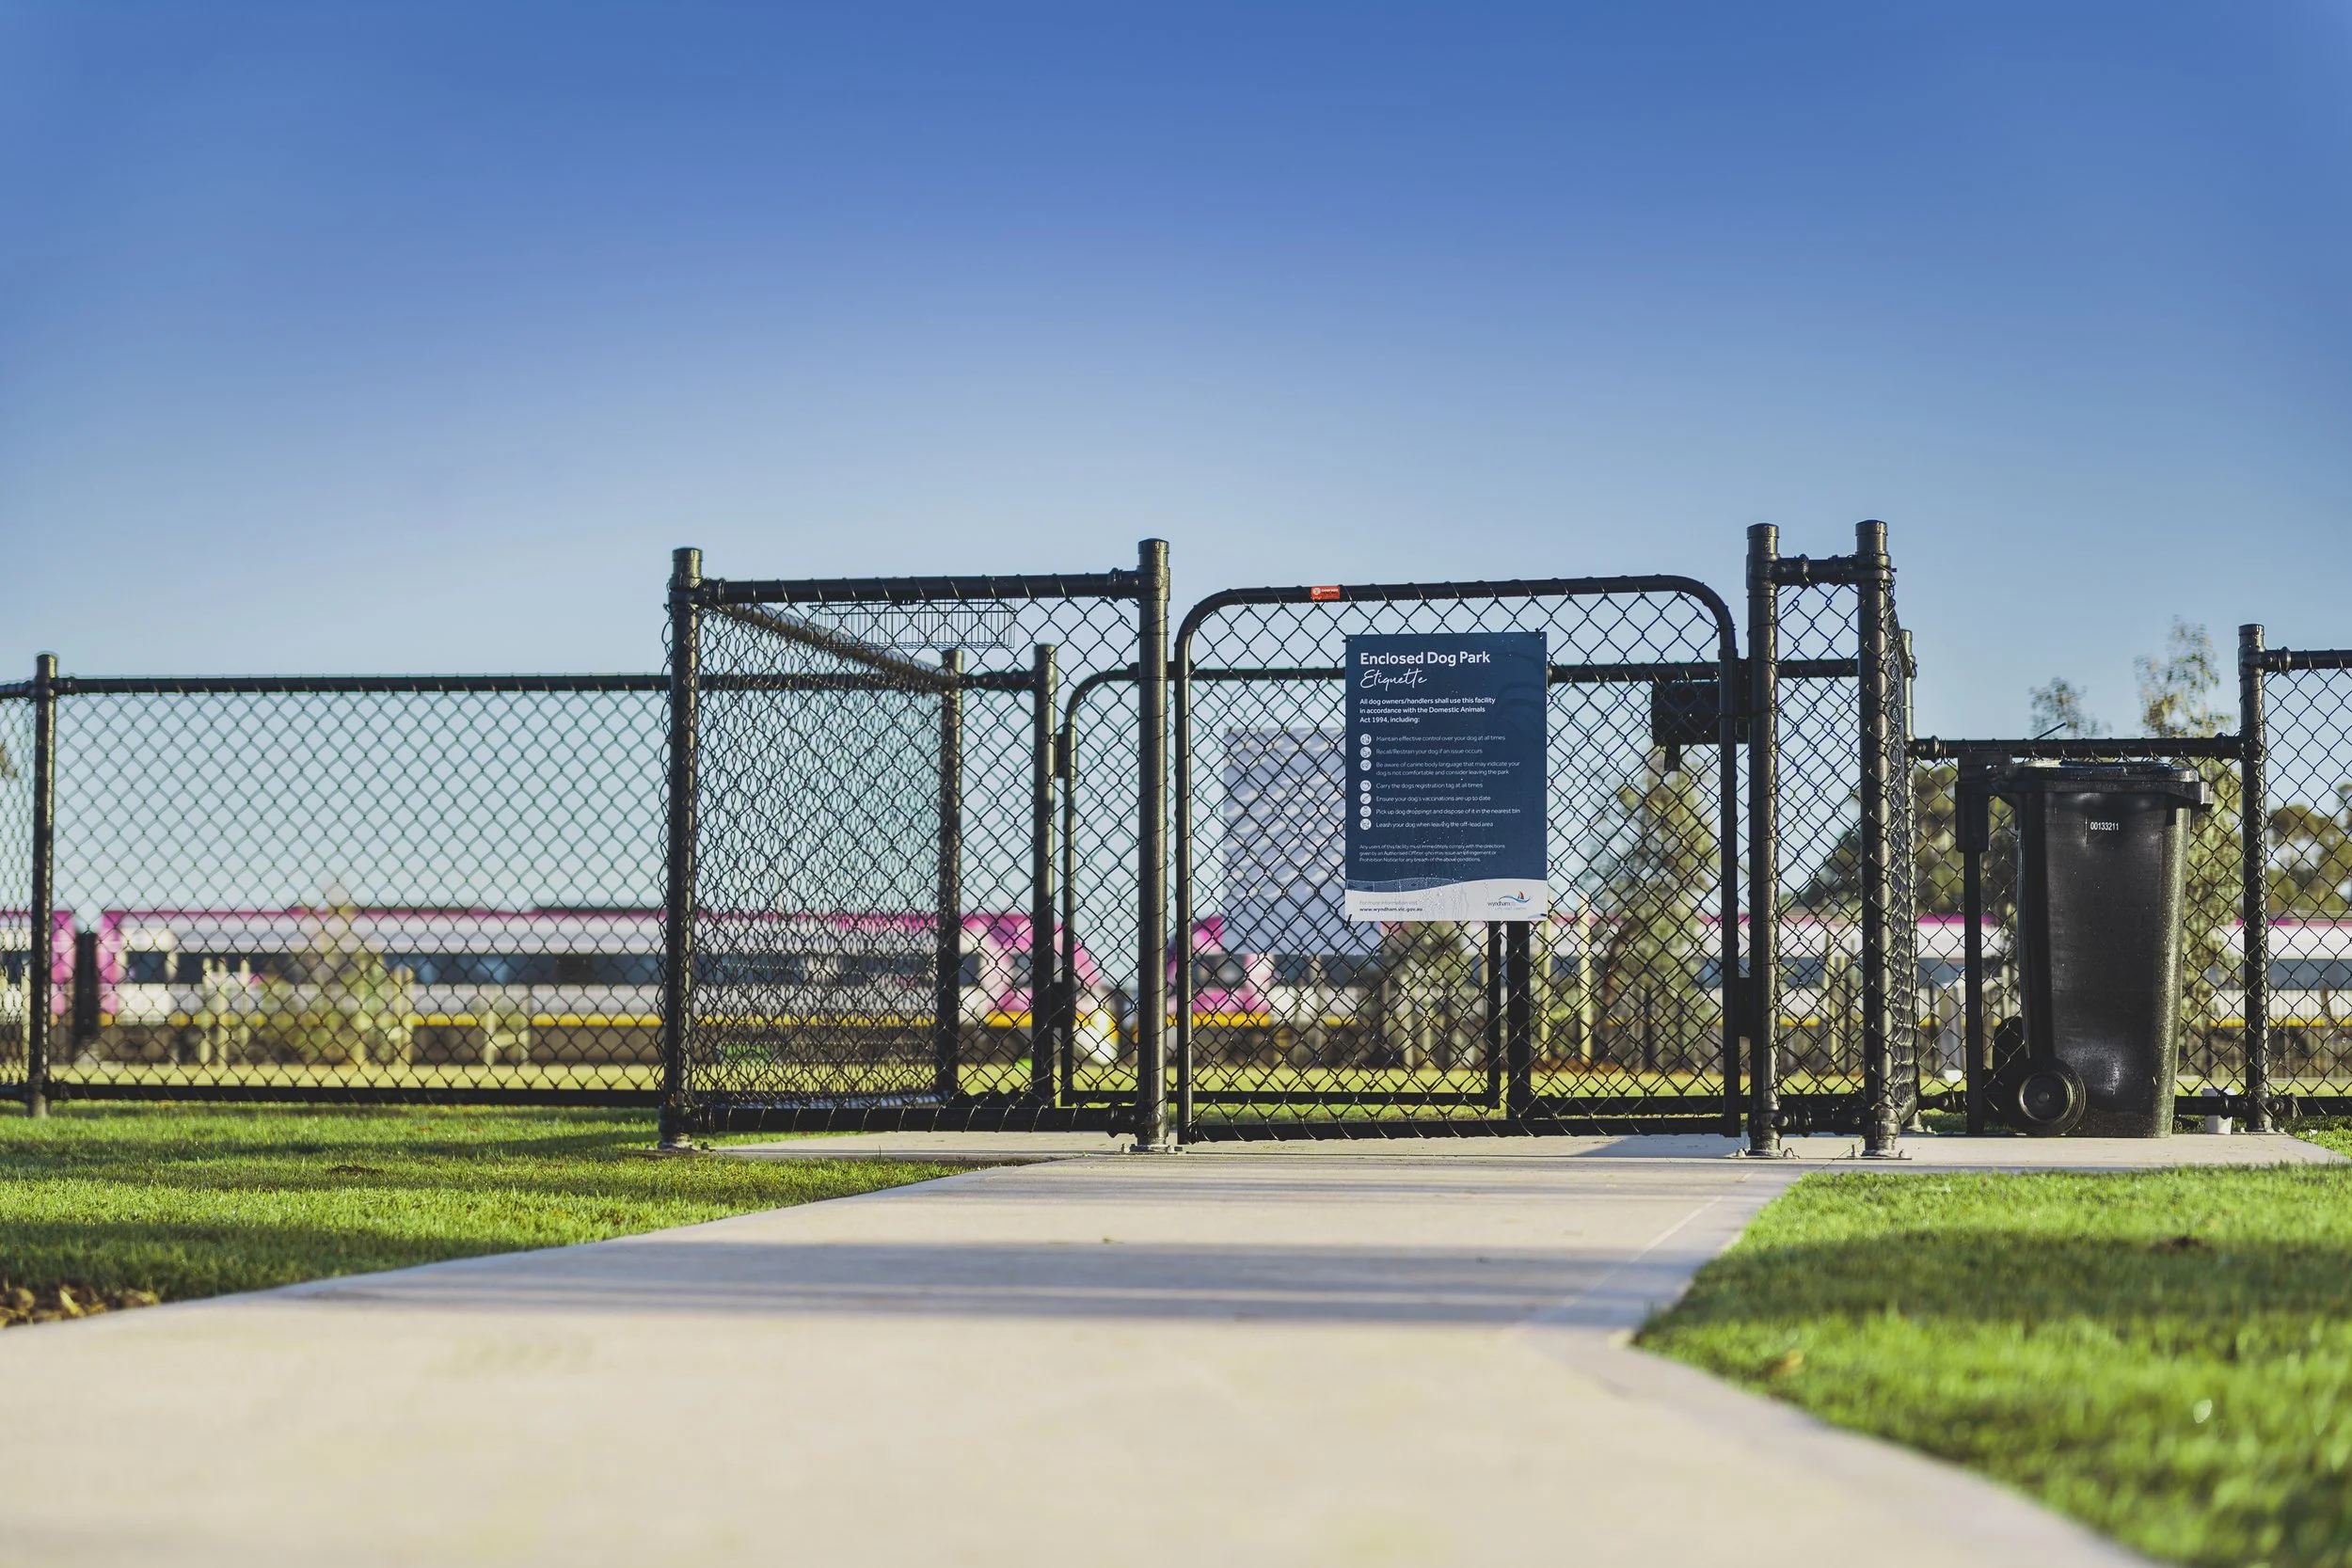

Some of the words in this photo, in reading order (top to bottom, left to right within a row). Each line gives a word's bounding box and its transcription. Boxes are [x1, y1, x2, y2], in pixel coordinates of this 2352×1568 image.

[1360, 652, 1423, 665] Enclosed
[1427, 652, 1456, 667] Dog
[1459, 651, 1490, 663] Park
[1359, 668, 1427, 691] Etiquette
[2090, 821, 2119, 831] 00133211
